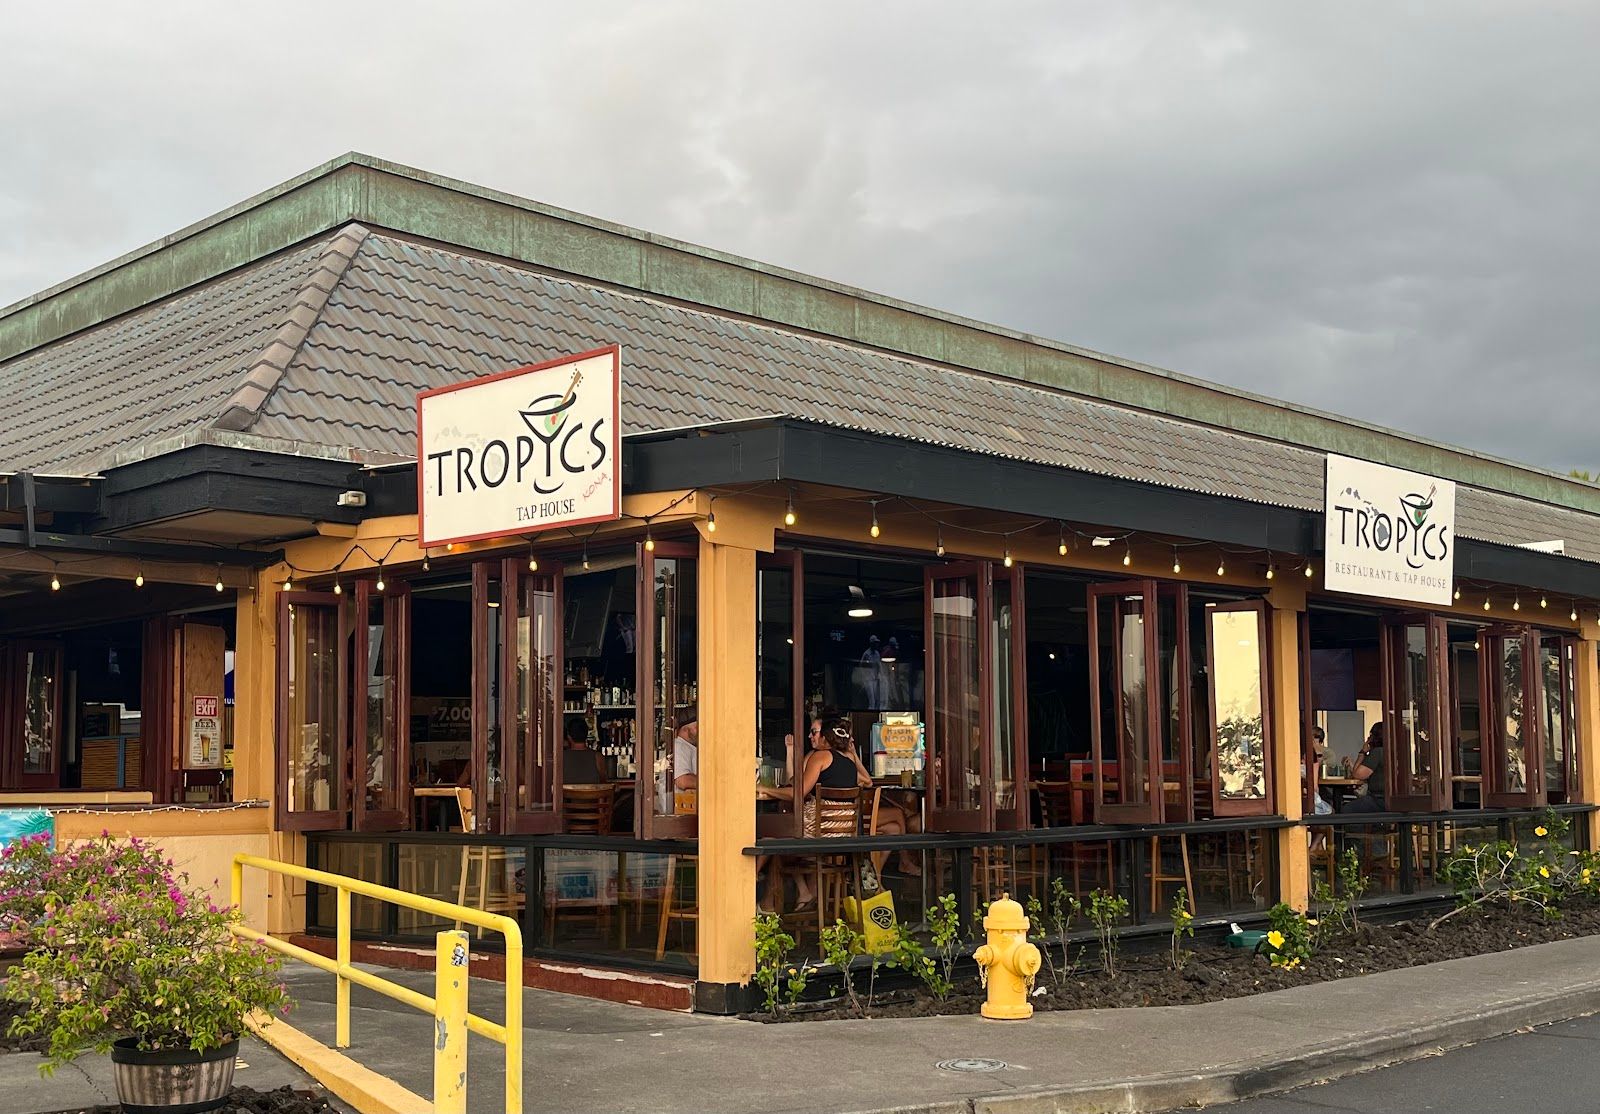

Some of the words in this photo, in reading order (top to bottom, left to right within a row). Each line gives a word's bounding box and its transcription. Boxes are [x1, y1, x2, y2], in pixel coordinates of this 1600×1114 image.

[428, 404, 606, 497] TROPYCS
[516, 504, 537, 522] TAP
[540, 499, 576, 518] HOUSE
[1334, 496, 1447, 565] TROPYCS
[1335, 562, 1392, 582] RESTAURANT
[1394, 572, 1400, 582] &
[1403, 572, 1418, 585] TAP
[1420, 575, 1447, 589] HOUSE
[195, 704, 216, 715] EXIT
[884, 735, 914, 743] NOON
